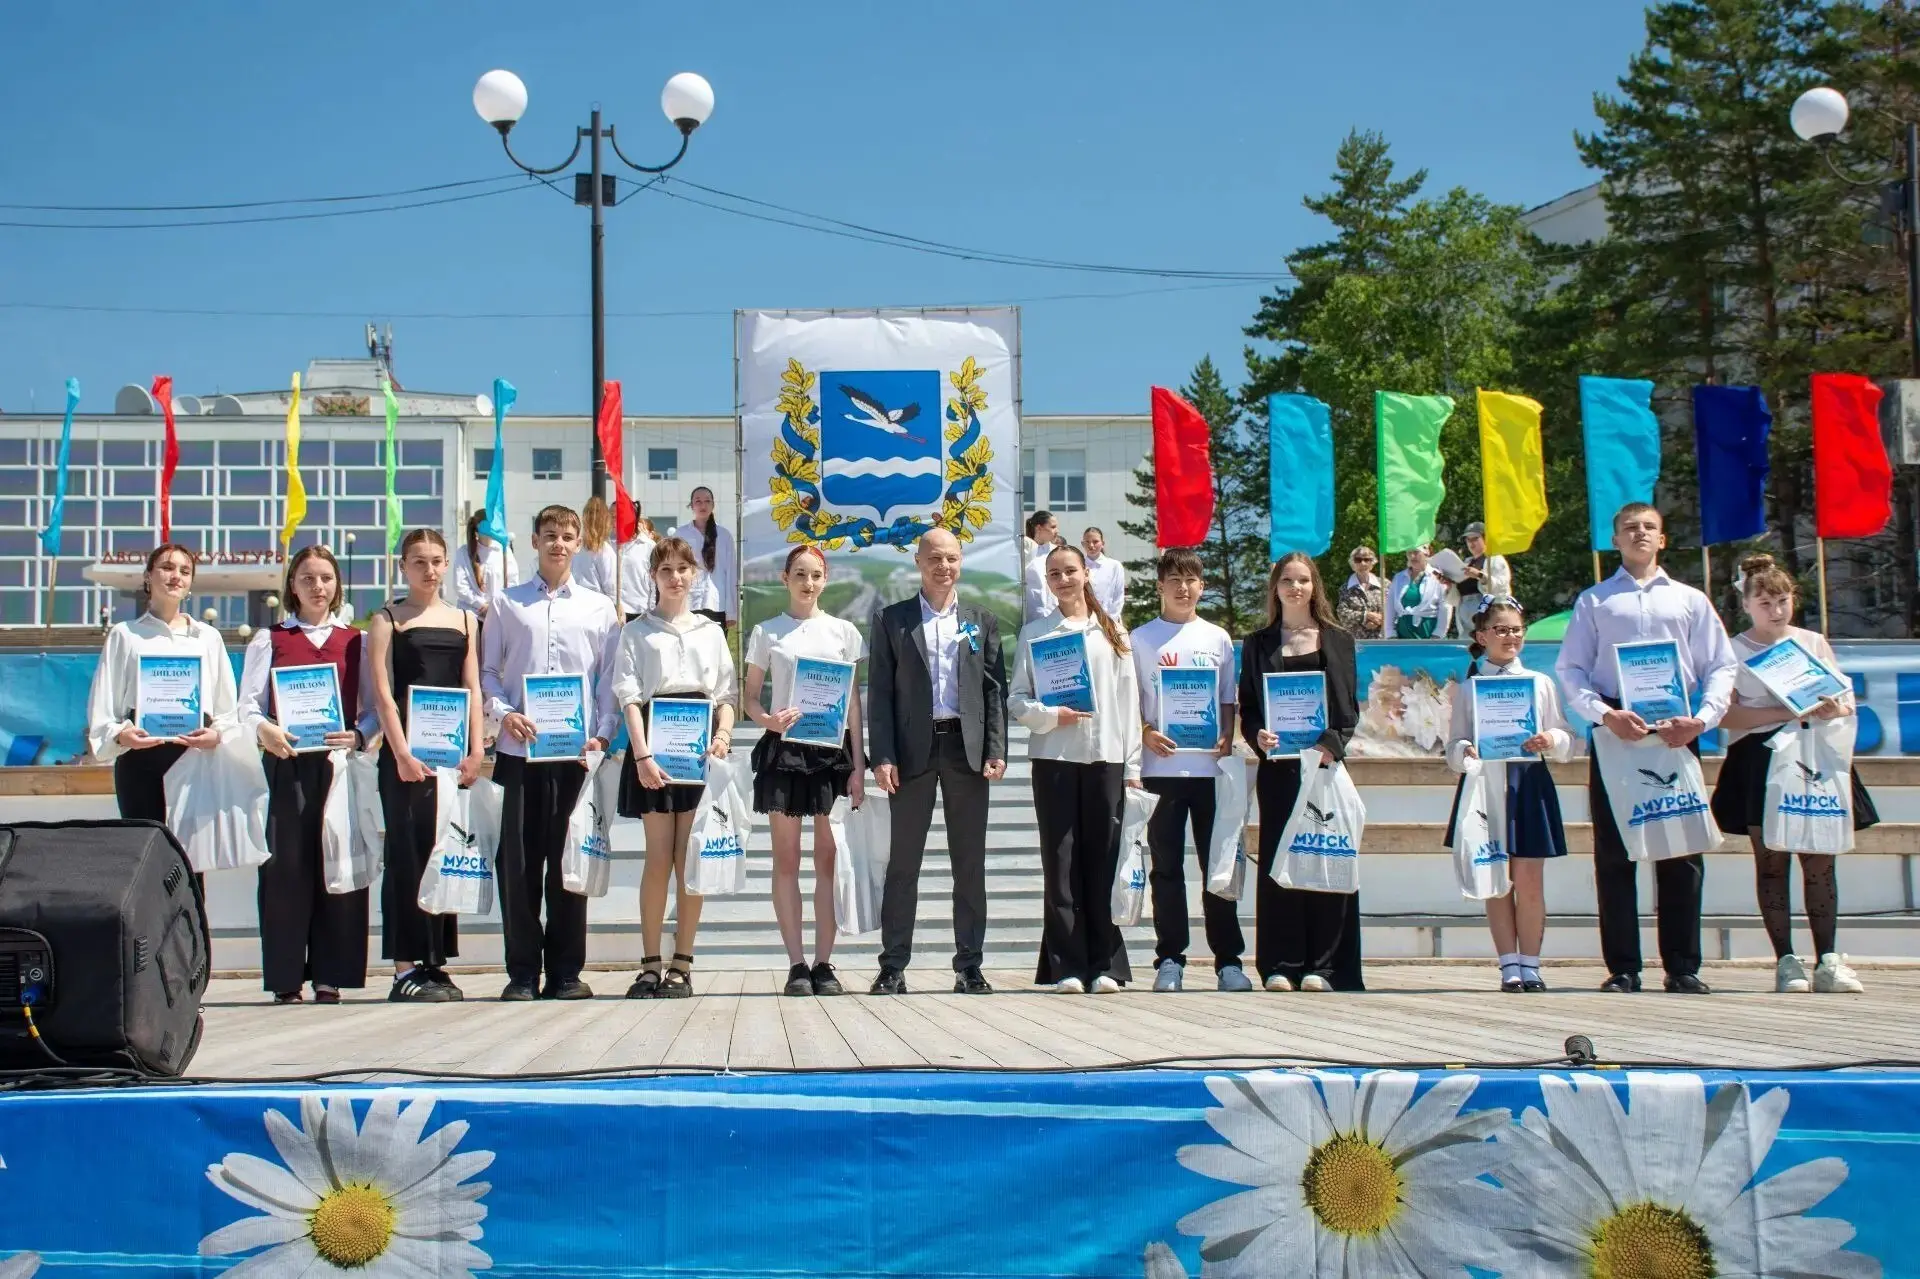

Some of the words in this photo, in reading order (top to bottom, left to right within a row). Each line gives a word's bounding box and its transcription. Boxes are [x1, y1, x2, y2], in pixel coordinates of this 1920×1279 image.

[1043, 647, 1077, 662] ДИПЛОМ
[1629, 656, 1668, 667] ДИПЛОМ
[151, 669, 191, 677] ДИПЛОМ
[804, 672, 841, 684] ДИПЛОМ
[287, 680, 326, 690] ДИПЛОМ
[1170, 682, 1207, 690] ДИПЛОМ
[535, 690, 574, 699] ДИПЛОМ
[1276, 688, 1315, 697] ДИПЛОМ
[1484, 691, 1525, 700] ДИПЛОМ
[420, 703, 457, 712] ДИПЛОМ
[661, 715, 699, 723] ДИПЛОМ
[1632, 792, 1701, 817] АМУРСК
[1783, 793, 1840, 808] АМУРСК
[1293, 832, 1350, 848] МУРСК
[443, 854, 488, 870] МУРСК
